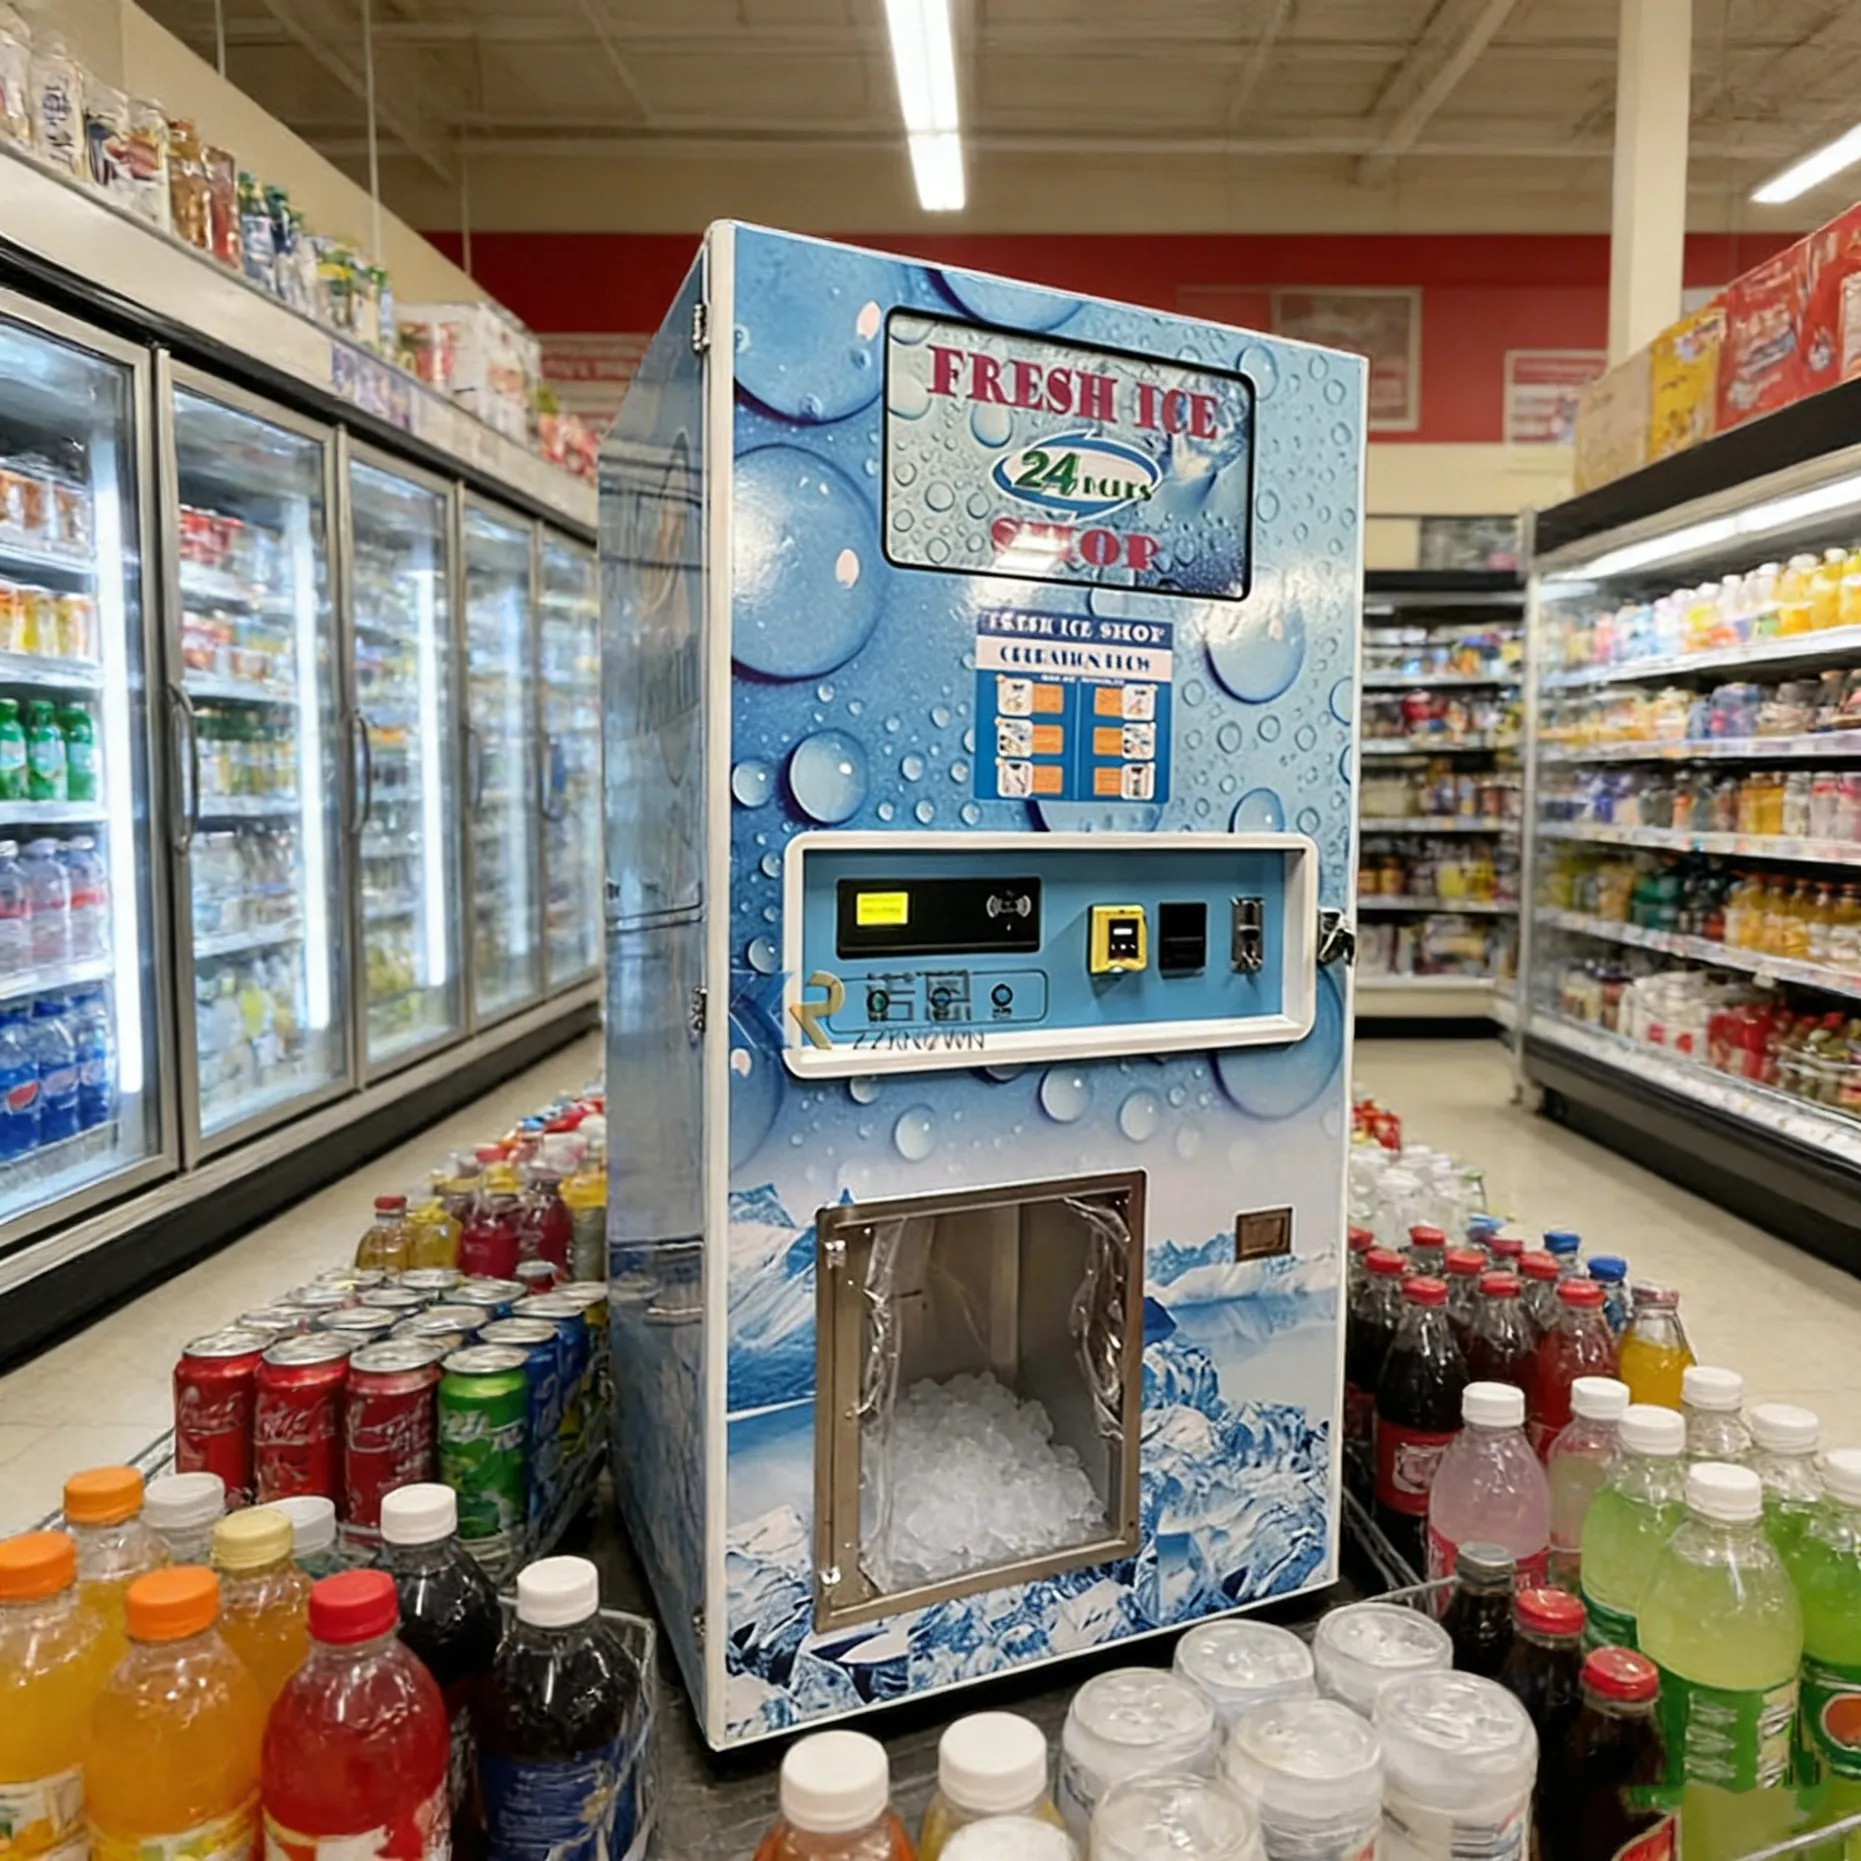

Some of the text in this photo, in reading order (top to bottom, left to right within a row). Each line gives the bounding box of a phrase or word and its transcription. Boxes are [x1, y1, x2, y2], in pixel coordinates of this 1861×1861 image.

[927, 345, 1218, 439] FRESH ICE
[1013, 450, 1080, 496] 24
